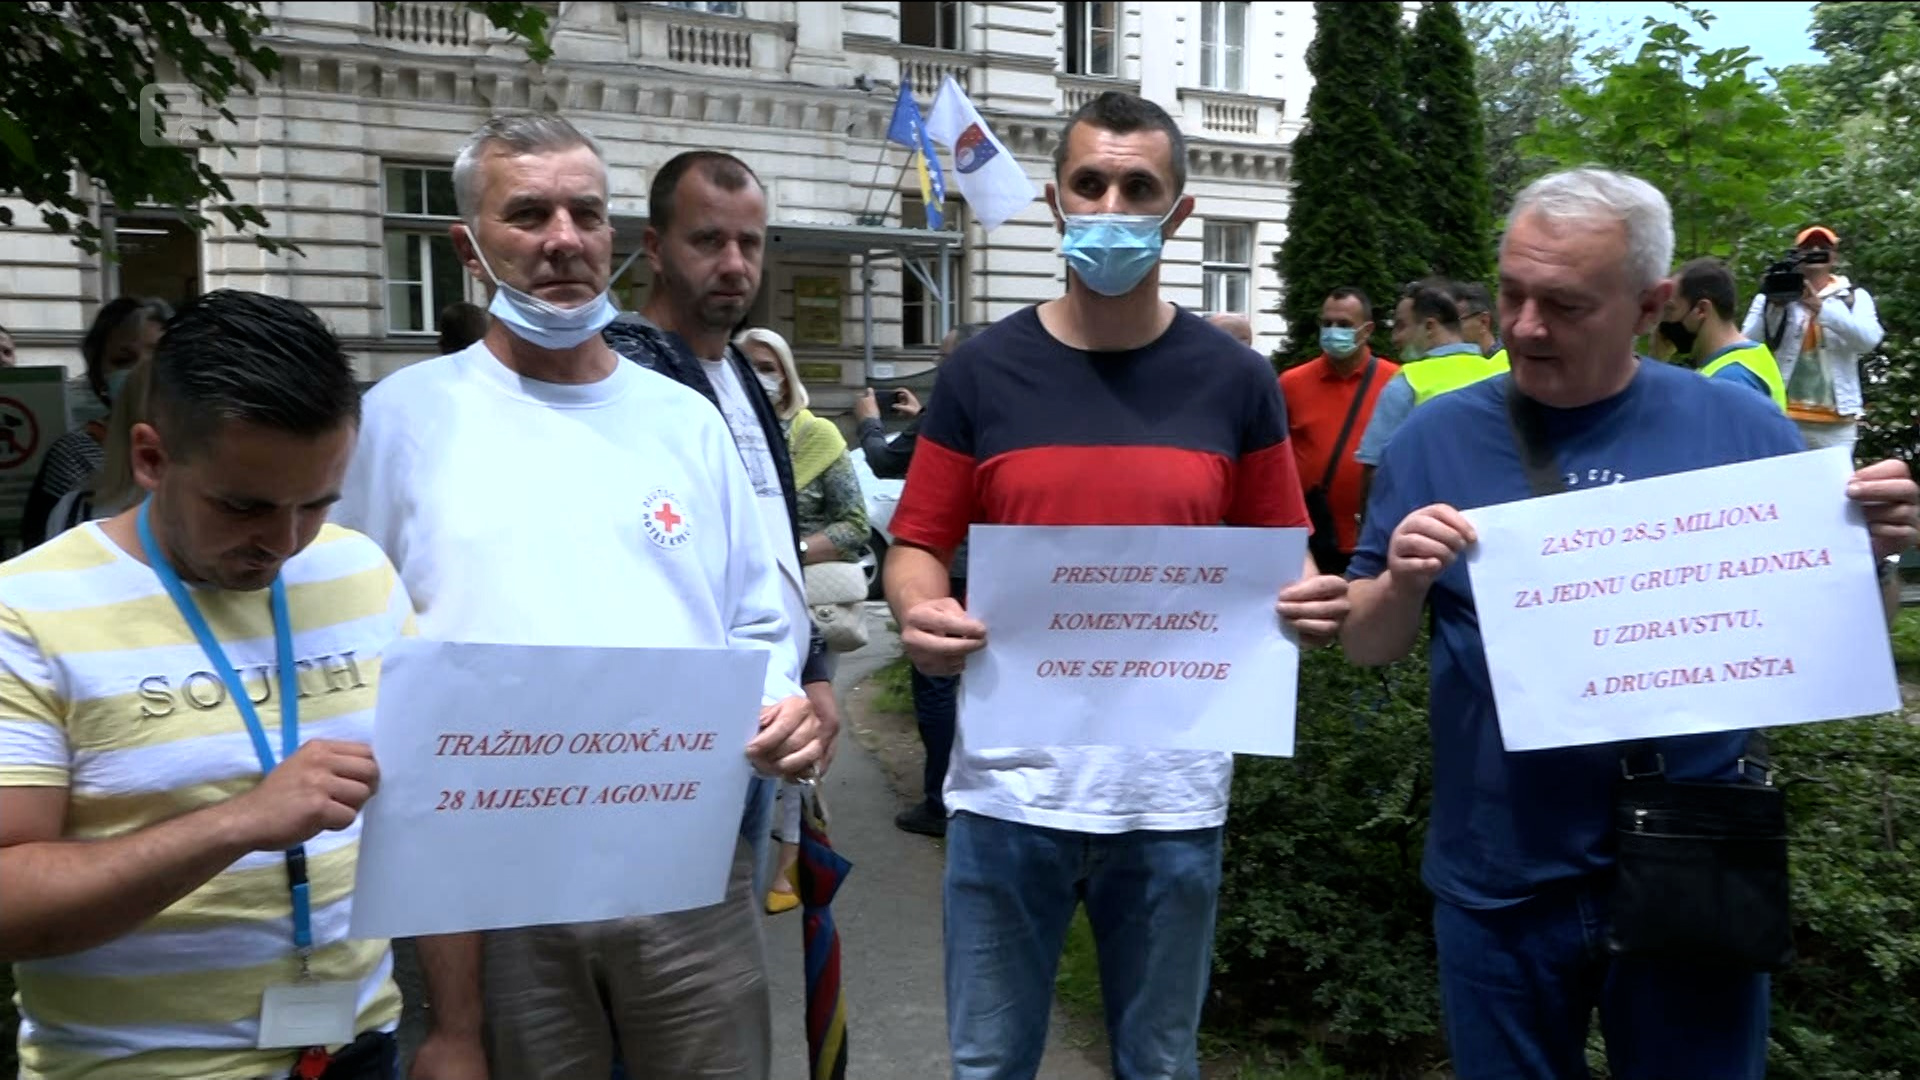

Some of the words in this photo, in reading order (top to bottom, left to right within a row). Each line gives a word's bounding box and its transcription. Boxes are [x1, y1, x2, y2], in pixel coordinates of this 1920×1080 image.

[1541, 527, 1616, 556] ZAŠTO
[1671, 503, 1779, 535] MILIONA
[1051, 566, 1157, 584] PRESUDE
[1159, 566, 1190, 584] SE
[1192, 566, 1228, 585] NE
[1514, 590, 1543, 608] ZA
[1546, 576, 1625, 605] JEDNU
[1630, 563, 1713, 591] GRUPU
[1717, 548, 1833, 579] RADNIKA
[1048, 611, 1219, 633] KOMENTARIŠU,
[1593, 628, 1611, 647] U
[1036, 660, 1086, 678] ONE
[1088, 661, 1118, 677] SE
[1121, 661, 1231, 681] PROVODE
[1579, 681, 1598, 698] A
[1603, 666, 1714, 695] DRUGIMA
[1721, 655, 1797, 684] NIŠTA
[434, 730, 562, 756] TRAŽIMO
[569, 727, 719, 754] OKONČANJE
[435, 790, 465, 810] 28
[470, 785, 590, 810] MJESECI
[592, 780, 702, 804] AGONIJE
